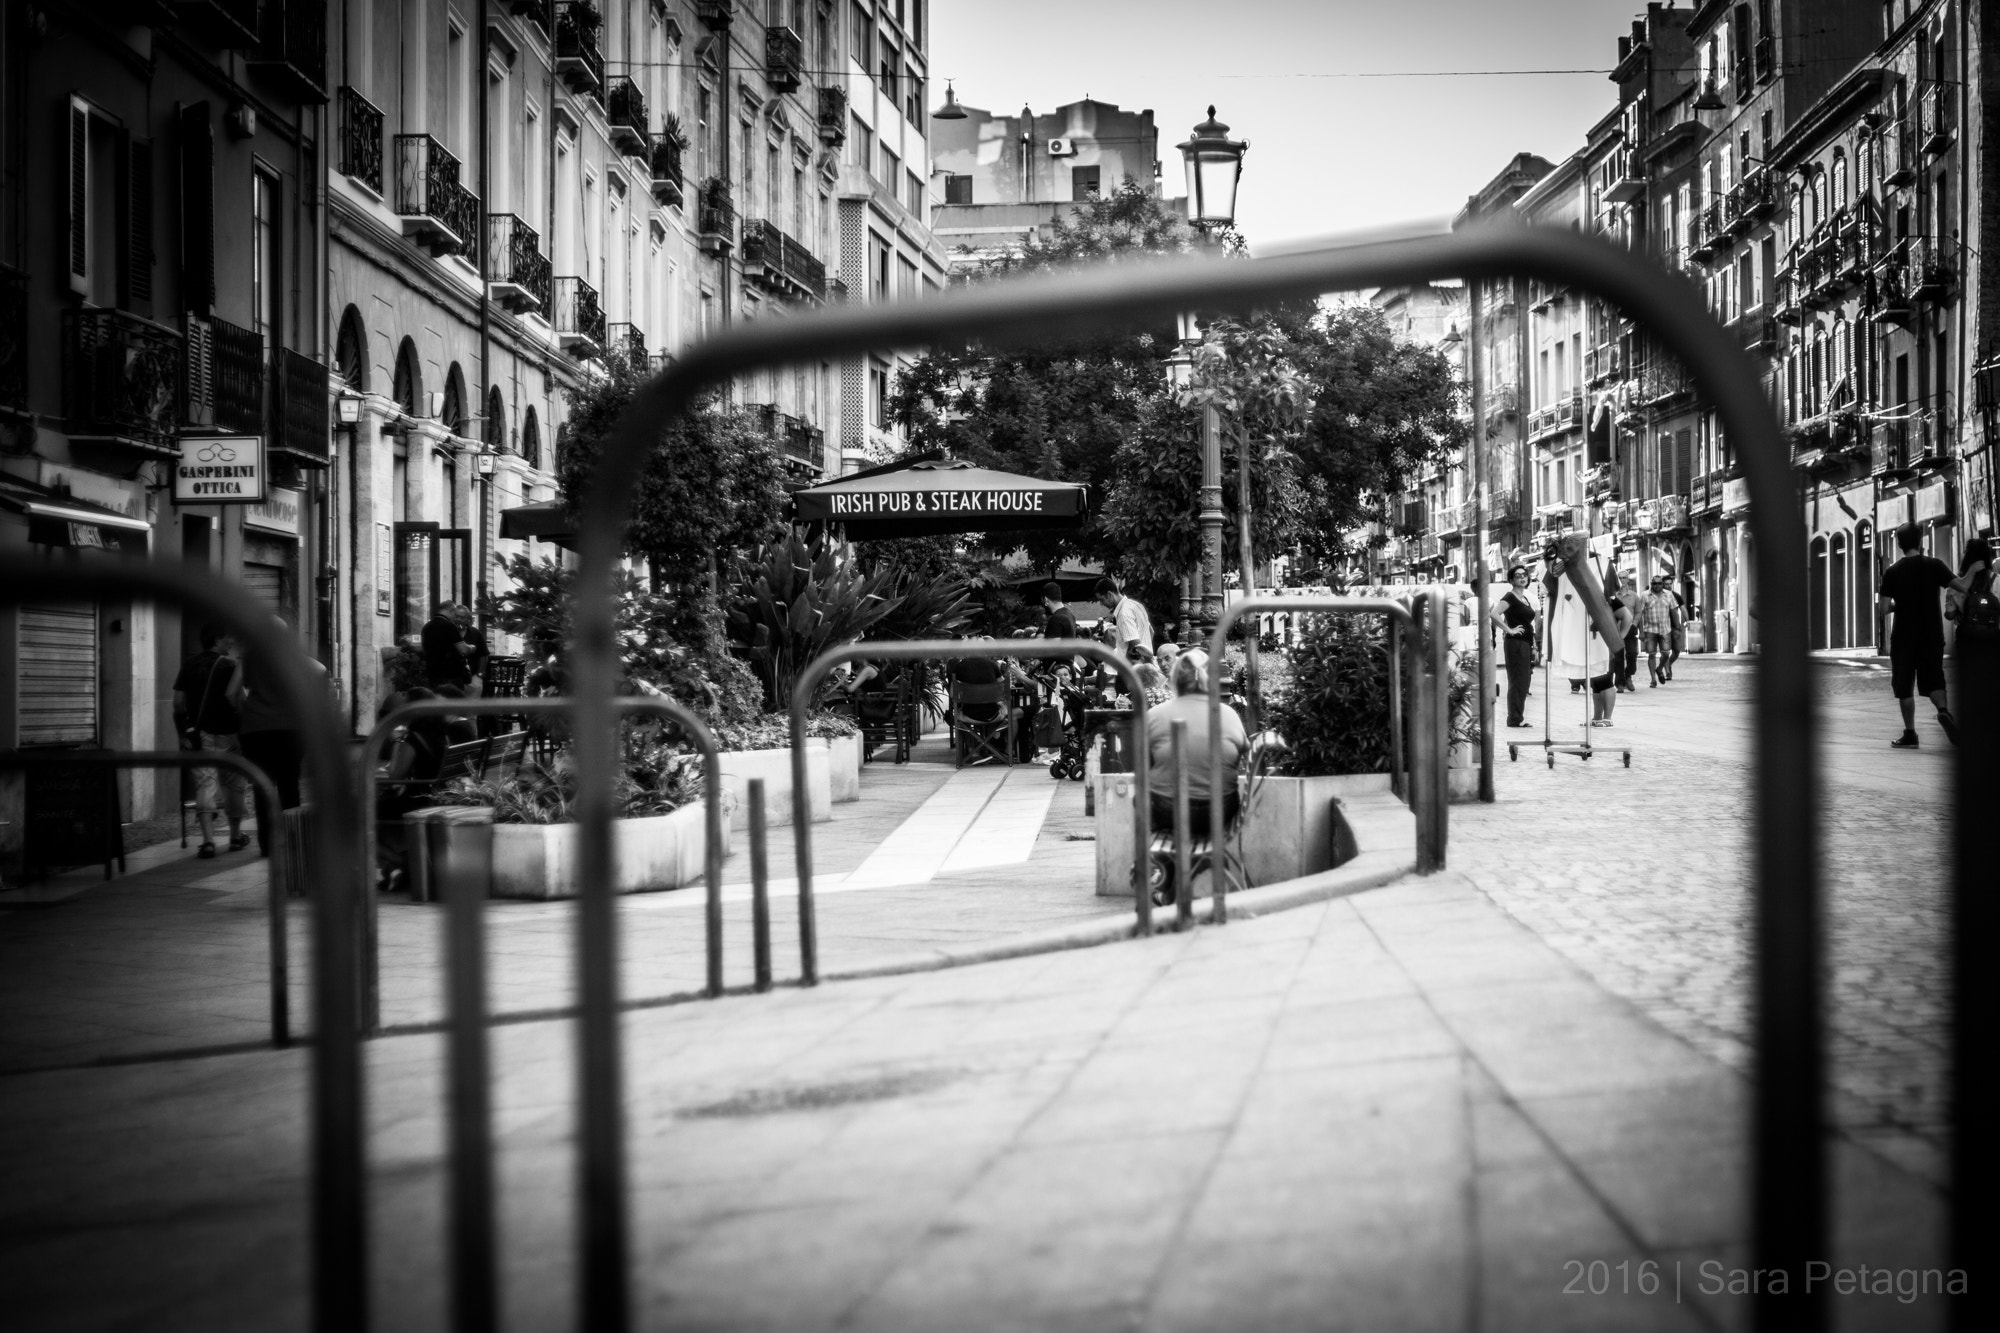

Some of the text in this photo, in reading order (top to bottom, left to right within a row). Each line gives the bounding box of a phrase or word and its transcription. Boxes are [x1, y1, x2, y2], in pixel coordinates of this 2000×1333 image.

[179, 465, 254, 478] GASPERINI
[192, 482, 242, 494] OTTICA
[831, 491, 1043, 514] IRISH PUB & STEAK HOUSE
